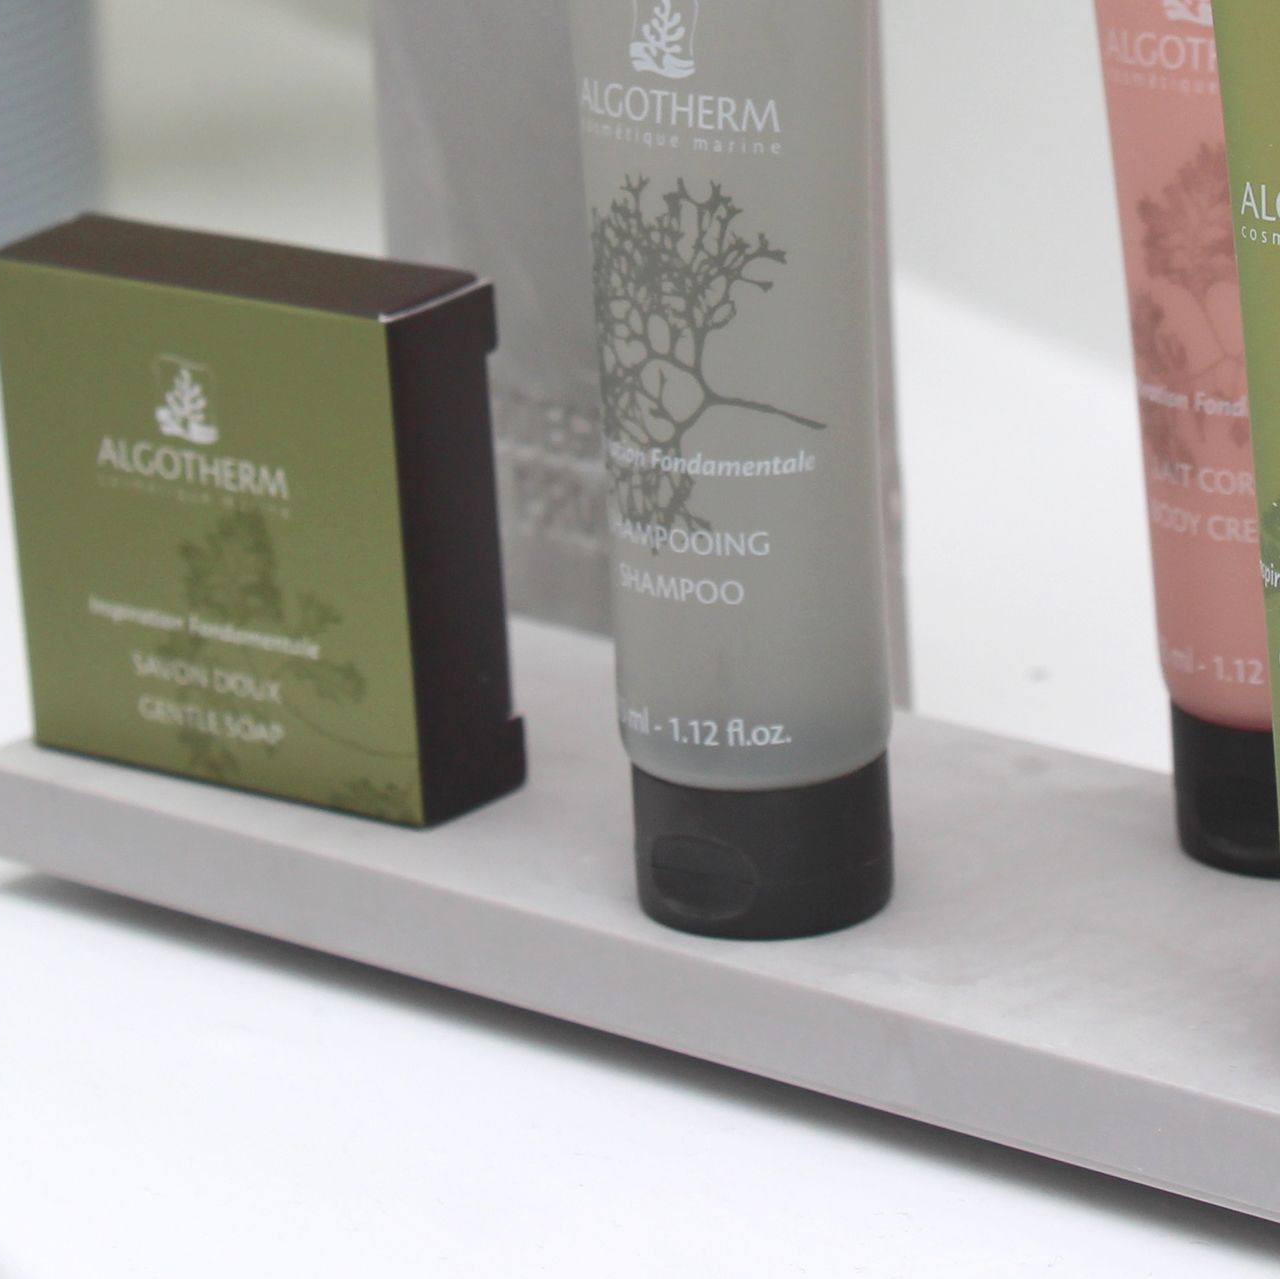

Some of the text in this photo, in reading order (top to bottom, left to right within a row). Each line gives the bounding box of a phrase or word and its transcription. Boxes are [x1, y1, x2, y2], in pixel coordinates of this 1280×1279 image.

[578, 77, 781, 133] ALGOTHERM
[693, 135, 783, 155] marine
[1195, 390, 1248, 417] Fond
[96, 436, 290, 501] ALGOTHERM
[651, 447, 817, 477] Fondamentale
[1198, 467, 1256, 497] COR
[612, 517, 771, 557] AMPOOING
[1207, 515, 1260, 544] CRE
[131, 651, 282, 704] SAVON DOUX
[1213, 655, 1265, 685] 1.12
[670, 717, 720, 747] 1.12
[726, 718, 793, 748] fl.oz.
